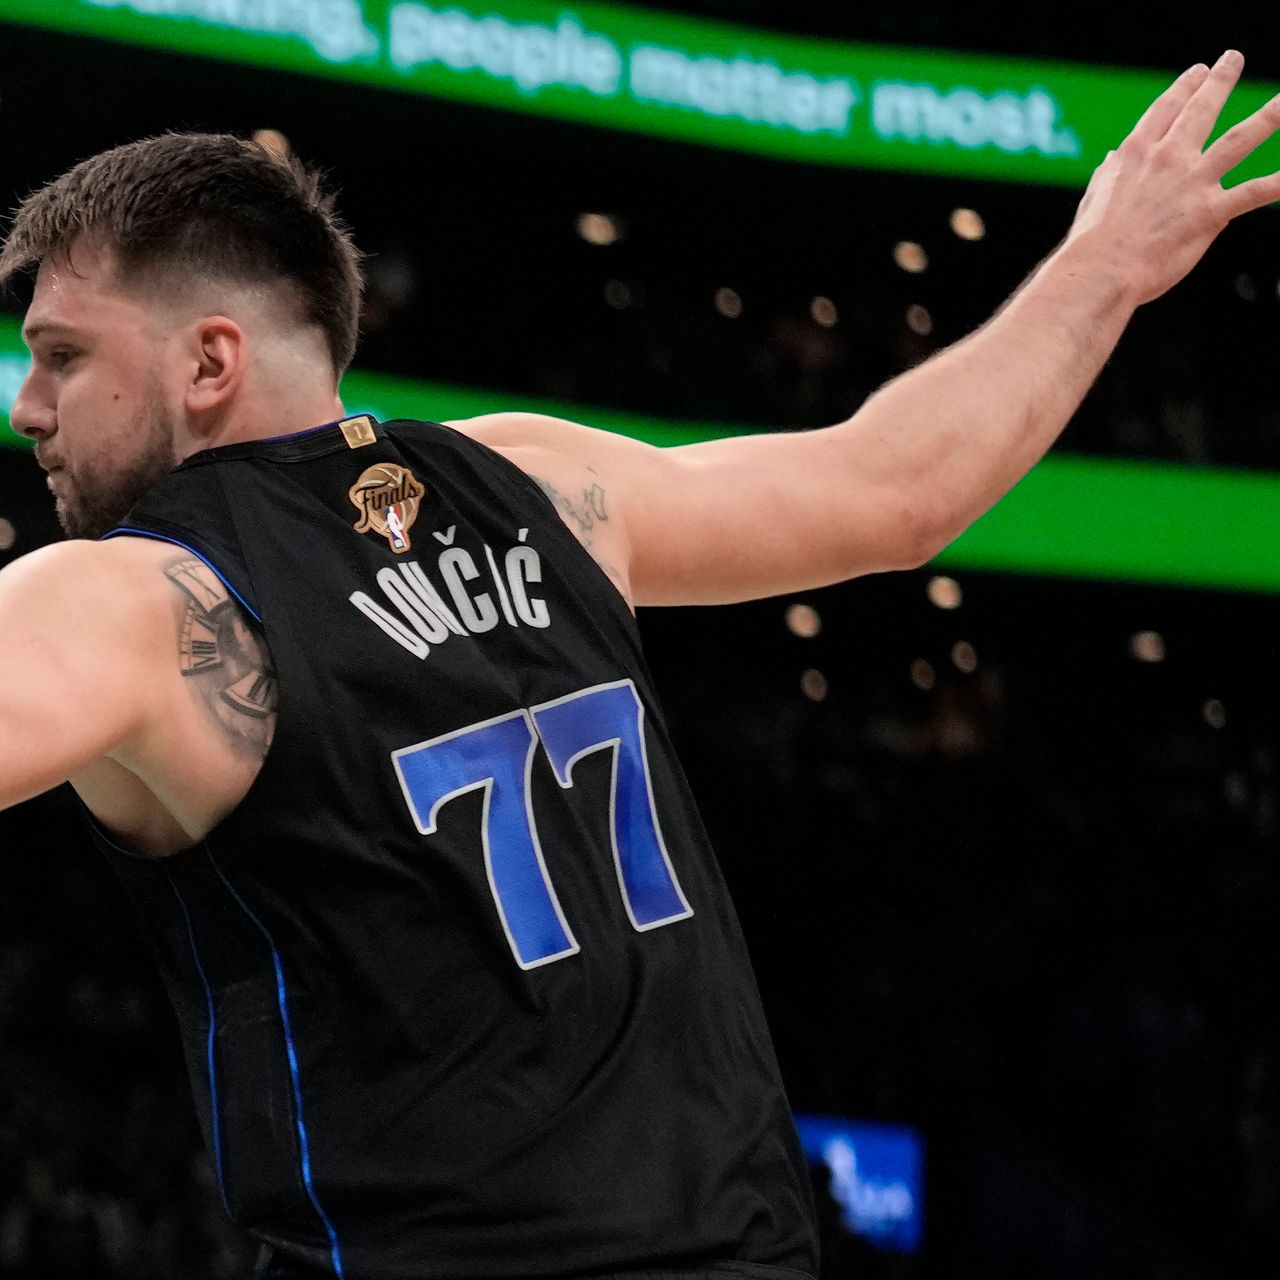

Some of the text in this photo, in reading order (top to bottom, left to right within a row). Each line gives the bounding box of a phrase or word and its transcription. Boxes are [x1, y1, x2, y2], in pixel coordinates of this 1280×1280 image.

[388, 2, 623, 96] people
[630, 46, 854, 138] matter
[872, 82, 1080, 158] most.
[354, 471, 420, 529] Finals
[391, 678, 694, 970] 77
